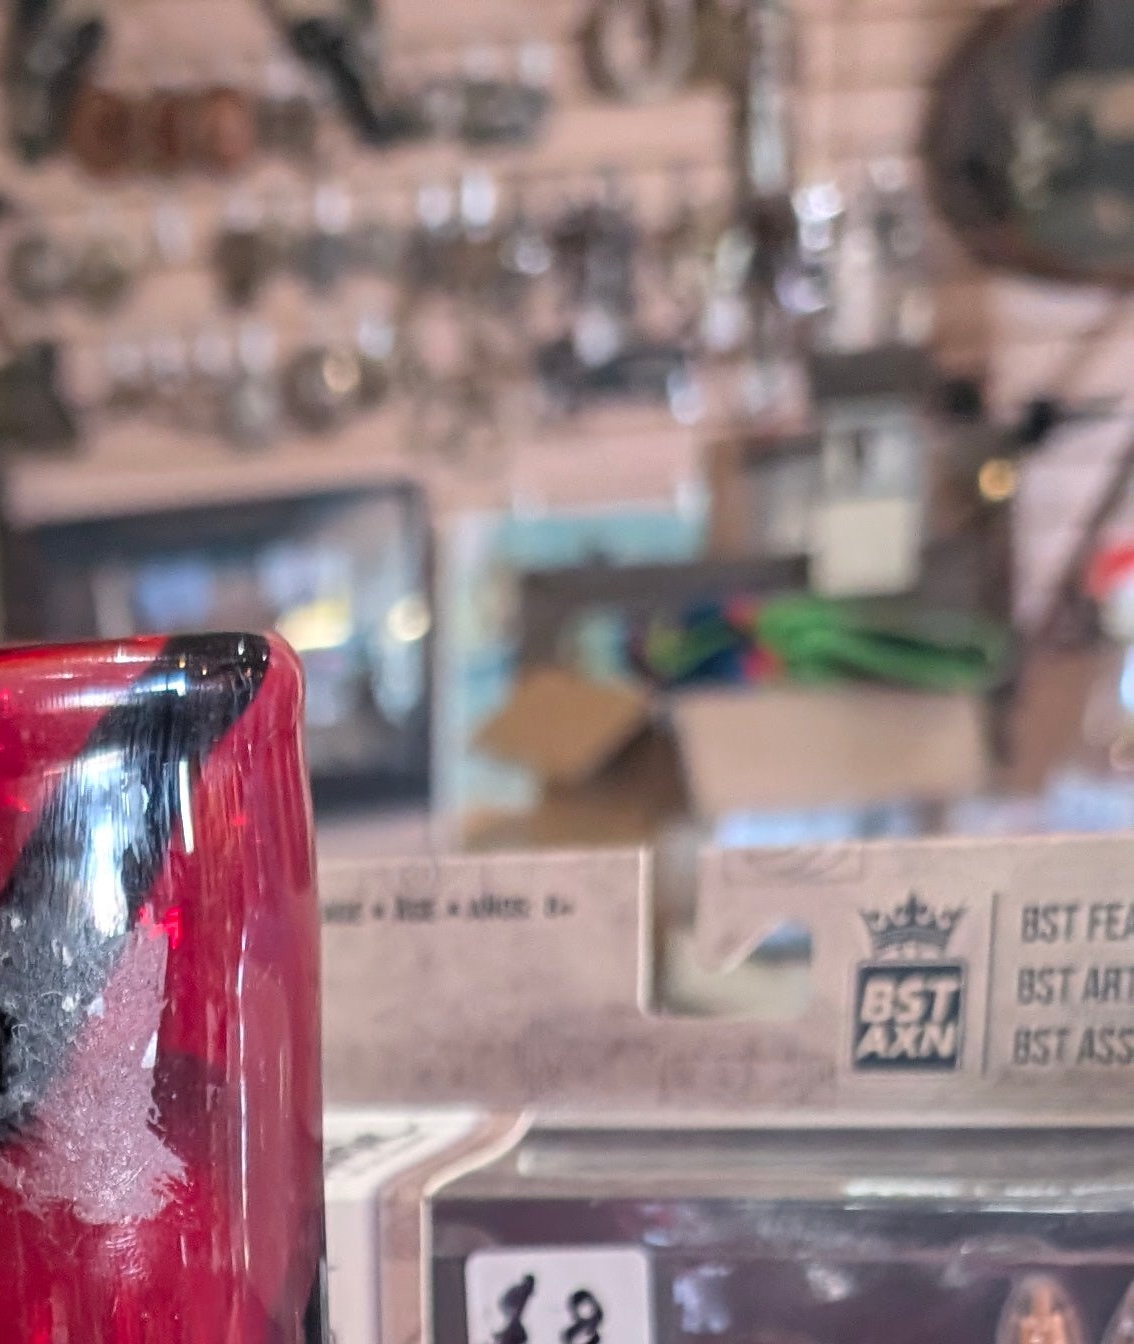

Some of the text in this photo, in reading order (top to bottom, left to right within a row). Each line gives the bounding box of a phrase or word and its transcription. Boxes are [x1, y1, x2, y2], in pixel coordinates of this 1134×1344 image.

[1021, 903, 1079, 943] BST
[859, 977, 959, 1022] BST
[1017, 966, 1075, 1005] BST
[855, 1022, 956, 1059] AXN
[1013, 1027, 1070, 1067] BST
